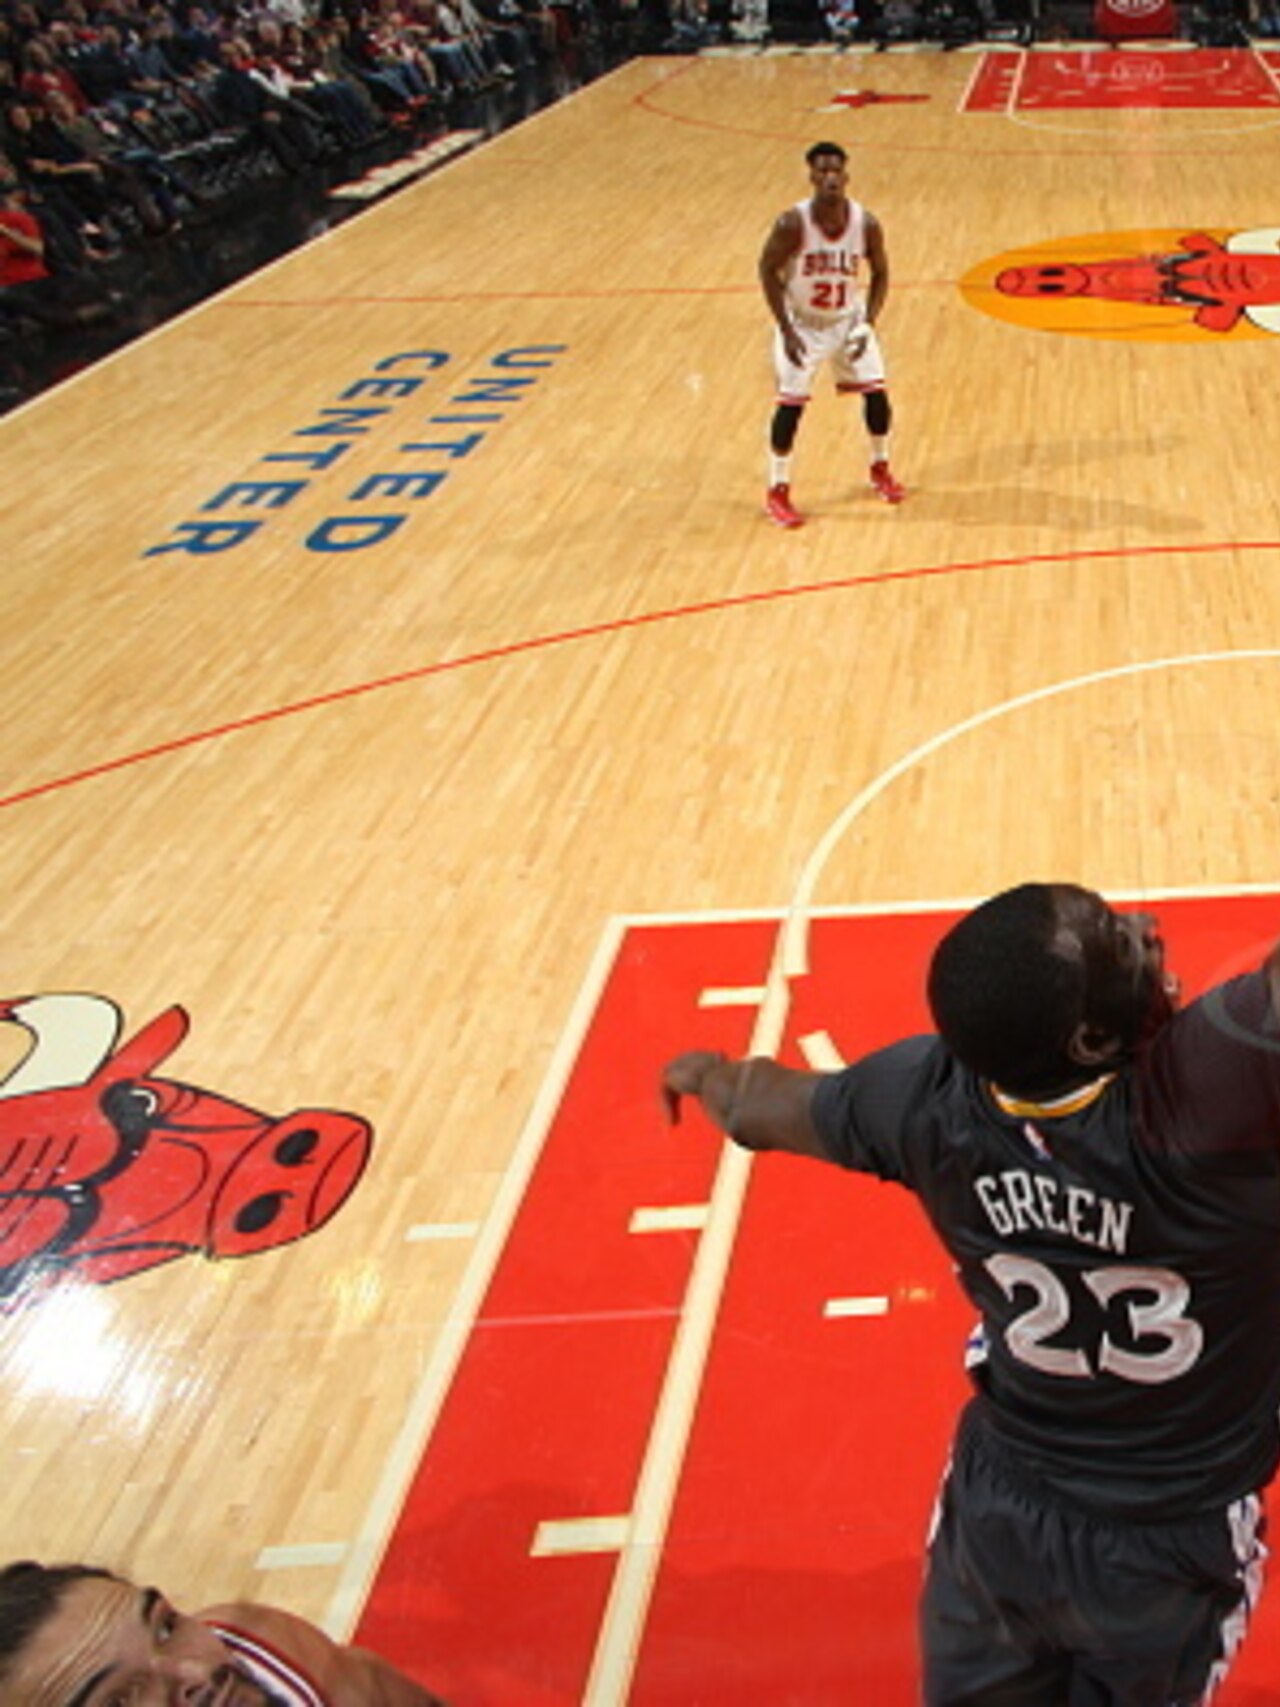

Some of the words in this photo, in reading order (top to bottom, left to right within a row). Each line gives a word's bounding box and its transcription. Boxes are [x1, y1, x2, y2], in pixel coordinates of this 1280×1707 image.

[809, 281, 846, 310] 21
[138, 349, 450, 558] CENTER
[304, 344, 568, 552] UNITED
[974, 1167, 1134, 1256] GREEN
[982, 1252, 1204, 1386] 23
